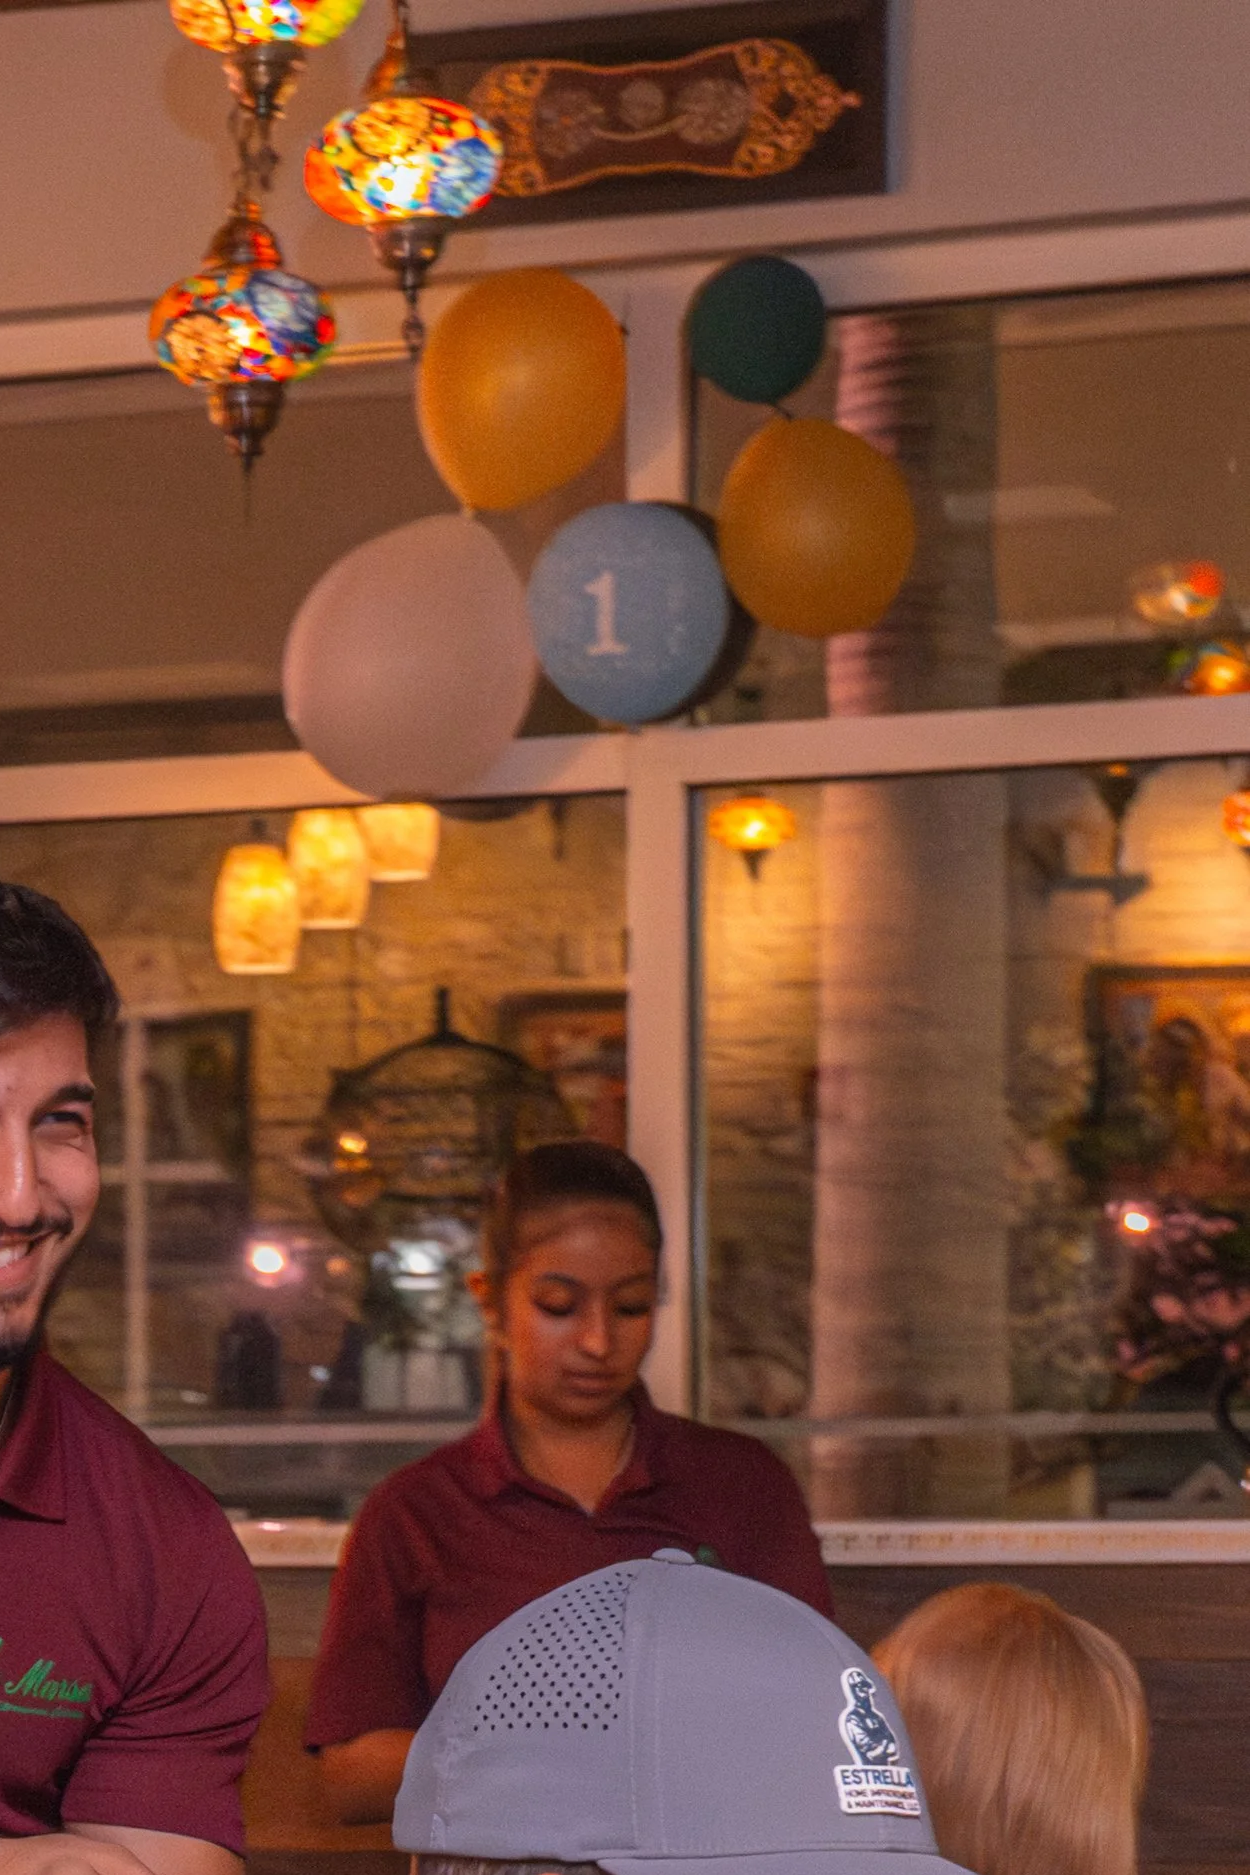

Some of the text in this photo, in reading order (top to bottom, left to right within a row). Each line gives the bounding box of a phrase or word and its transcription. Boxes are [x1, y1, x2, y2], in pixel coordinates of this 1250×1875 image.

[583, 569, 627, 656] 1
[4, 1658, 93, 1703] Marsa
[840, 1768, 914, 1788] ESTRELLA
